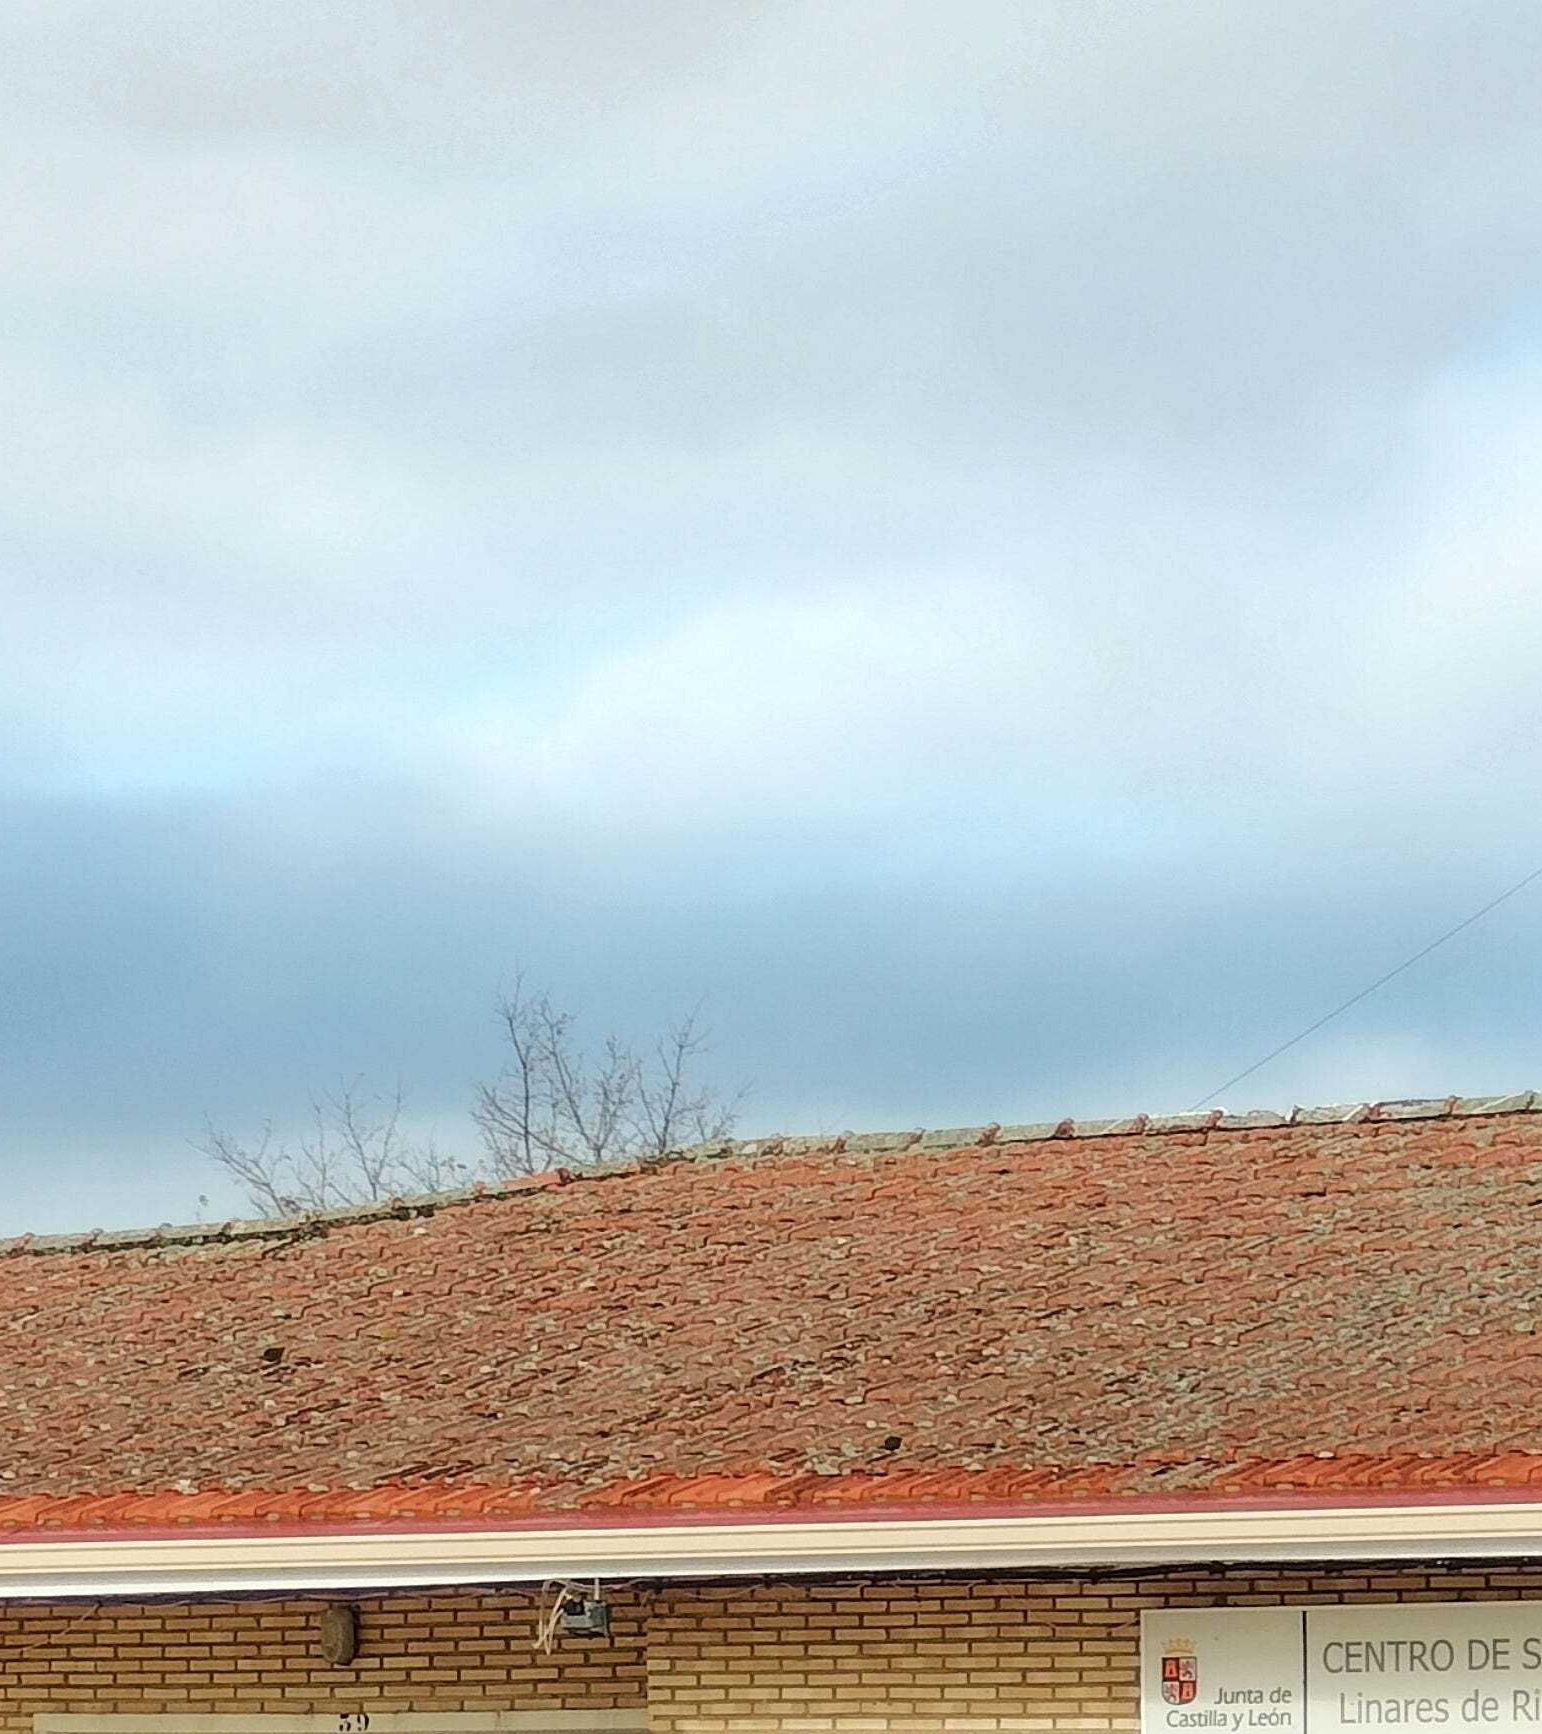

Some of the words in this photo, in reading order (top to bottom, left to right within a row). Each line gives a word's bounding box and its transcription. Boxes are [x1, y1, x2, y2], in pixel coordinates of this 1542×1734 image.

[1322, 1639, 1454, 1674] CENTRO
[1467, 1638, 1511, 1671] DE
[1214, 1687, 1264, 1705] Junta
[1269, 1686, 1293, 1704] de
[1339, 1692, 1450, 1724] Linares
[1461, 1689, 1500, 1722] de
[1166, 1709, 1228, 1728] Castilla
[1231, 1712, 1244, 1731] y
[1248, 1707, 1292, 1726] León
